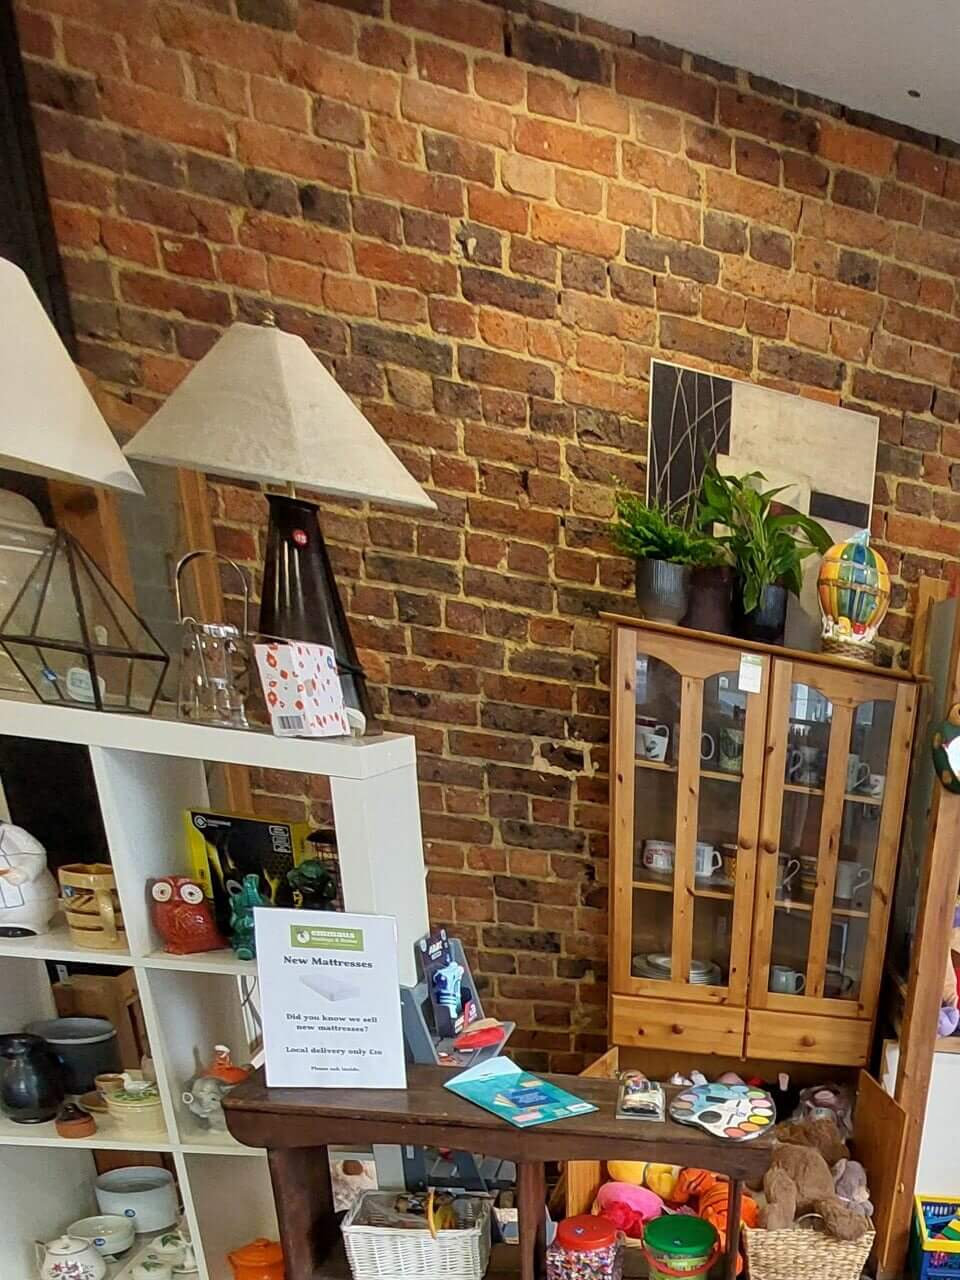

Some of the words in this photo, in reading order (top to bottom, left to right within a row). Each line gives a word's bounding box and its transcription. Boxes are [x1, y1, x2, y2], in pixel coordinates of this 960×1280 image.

[283, 955, 308, 965] New
[311, 957, 373, 969] Mattresses
[286, 1013, 301, 1021] Did
[303, 1014, 320, 1022] you
[322, 1014, 346, 1022] know
[318, 1025, 369, 1033] mattresses?
[310, 1047, 346, 1056] delivery
[348, 1048, 367, 1057] only
